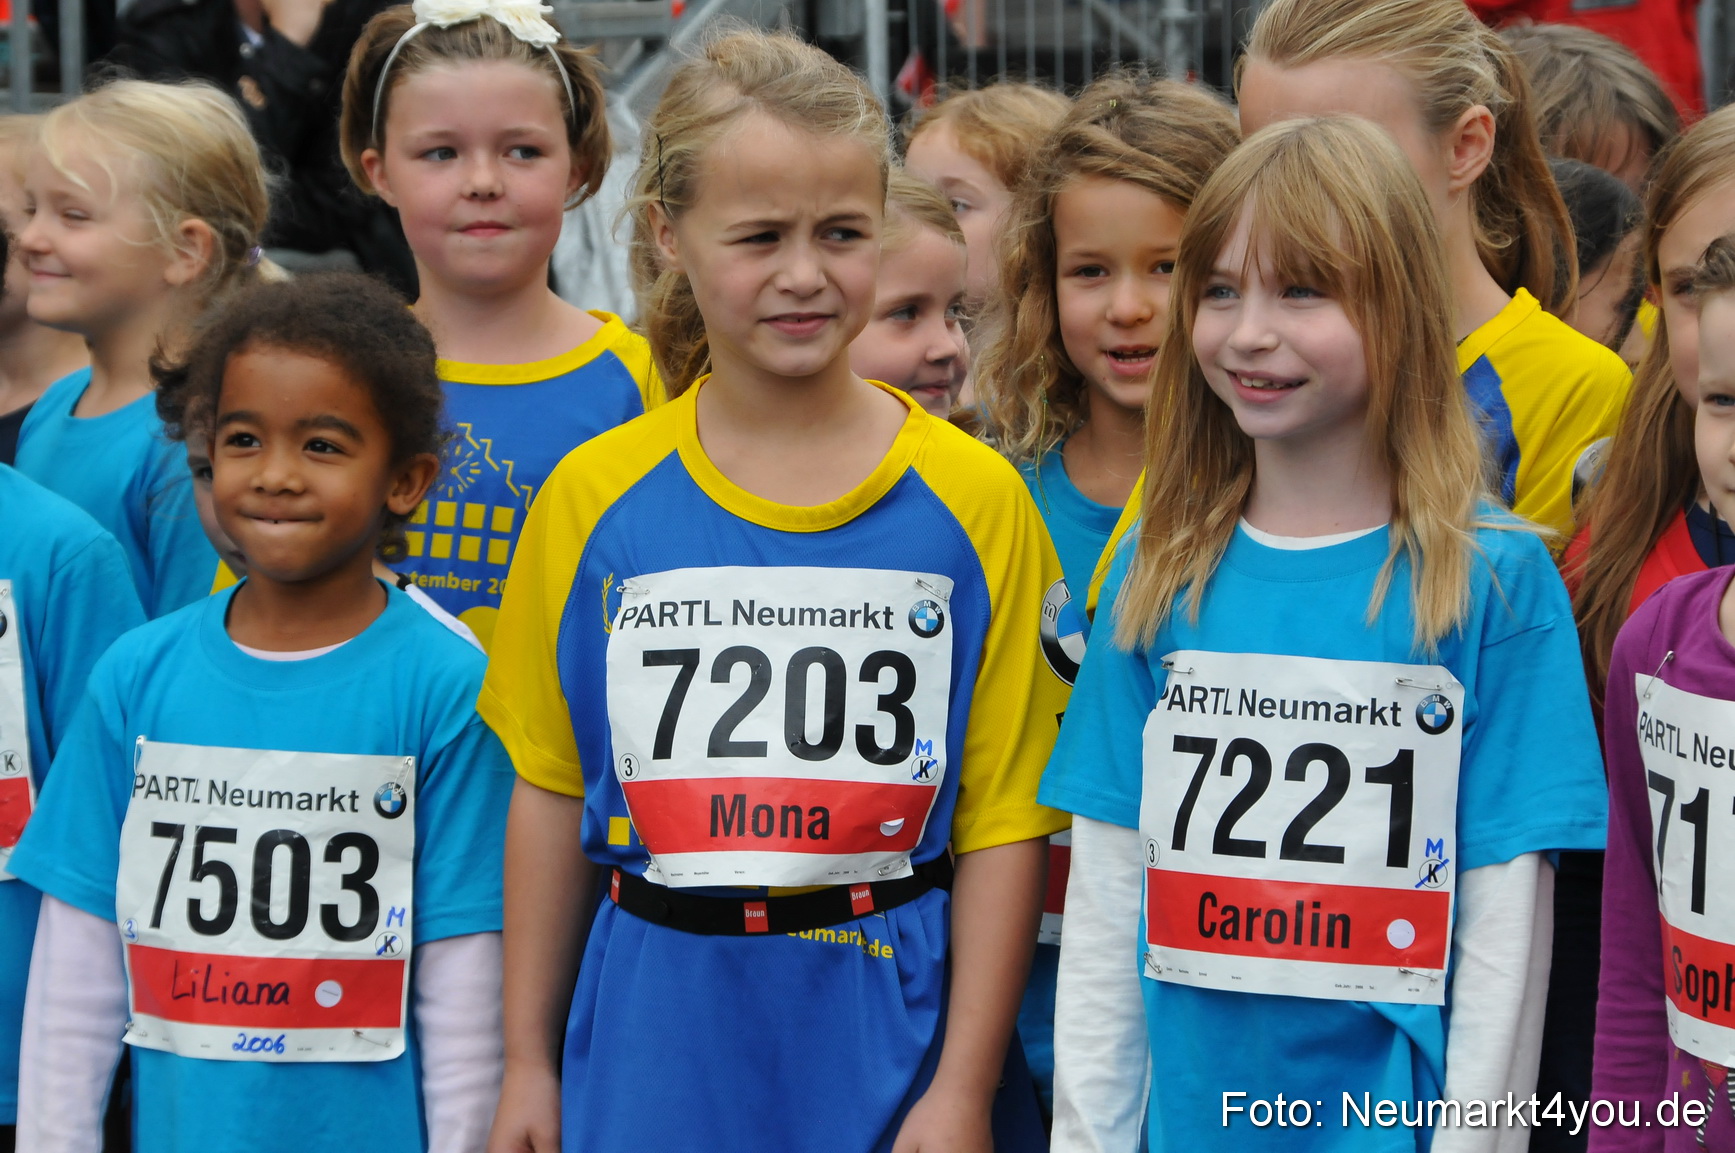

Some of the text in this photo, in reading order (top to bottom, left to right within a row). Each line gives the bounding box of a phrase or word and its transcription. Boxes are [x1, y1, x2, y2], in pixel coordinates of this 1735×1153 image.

[619, 600, 894, 631] PARTL Neumarkt
[642, 645, 917, 765] 7203
[1238, 688, 1402, 727] Neumarkt
[915, 738, 932, 756] M
[1640, 711, 1687, 759] PARTL
[4, 754, 15, 772] K
[624, 758, 634, 777] 3
[131, 773, 360, 813] PARTL Neumarkt
[1171, 734, 1415, 868] 7221
[709, 794, 830, 840] Mona
[1149, 843, 1156, 863] 3
[1425, 838, 1444, 860] M
[1648, 769, 1735, 916] 71
[149, 821, 380, 942] 7503
[851, 889, 870, 900] Braun
[386, 906, 406, 928] M
[745, 909, 765, 918] Braun
[1198, 891, 1350, 949] Carolin
[125, 921, 135, 939] 3
[232, 1033, 286, 1054] 2006
